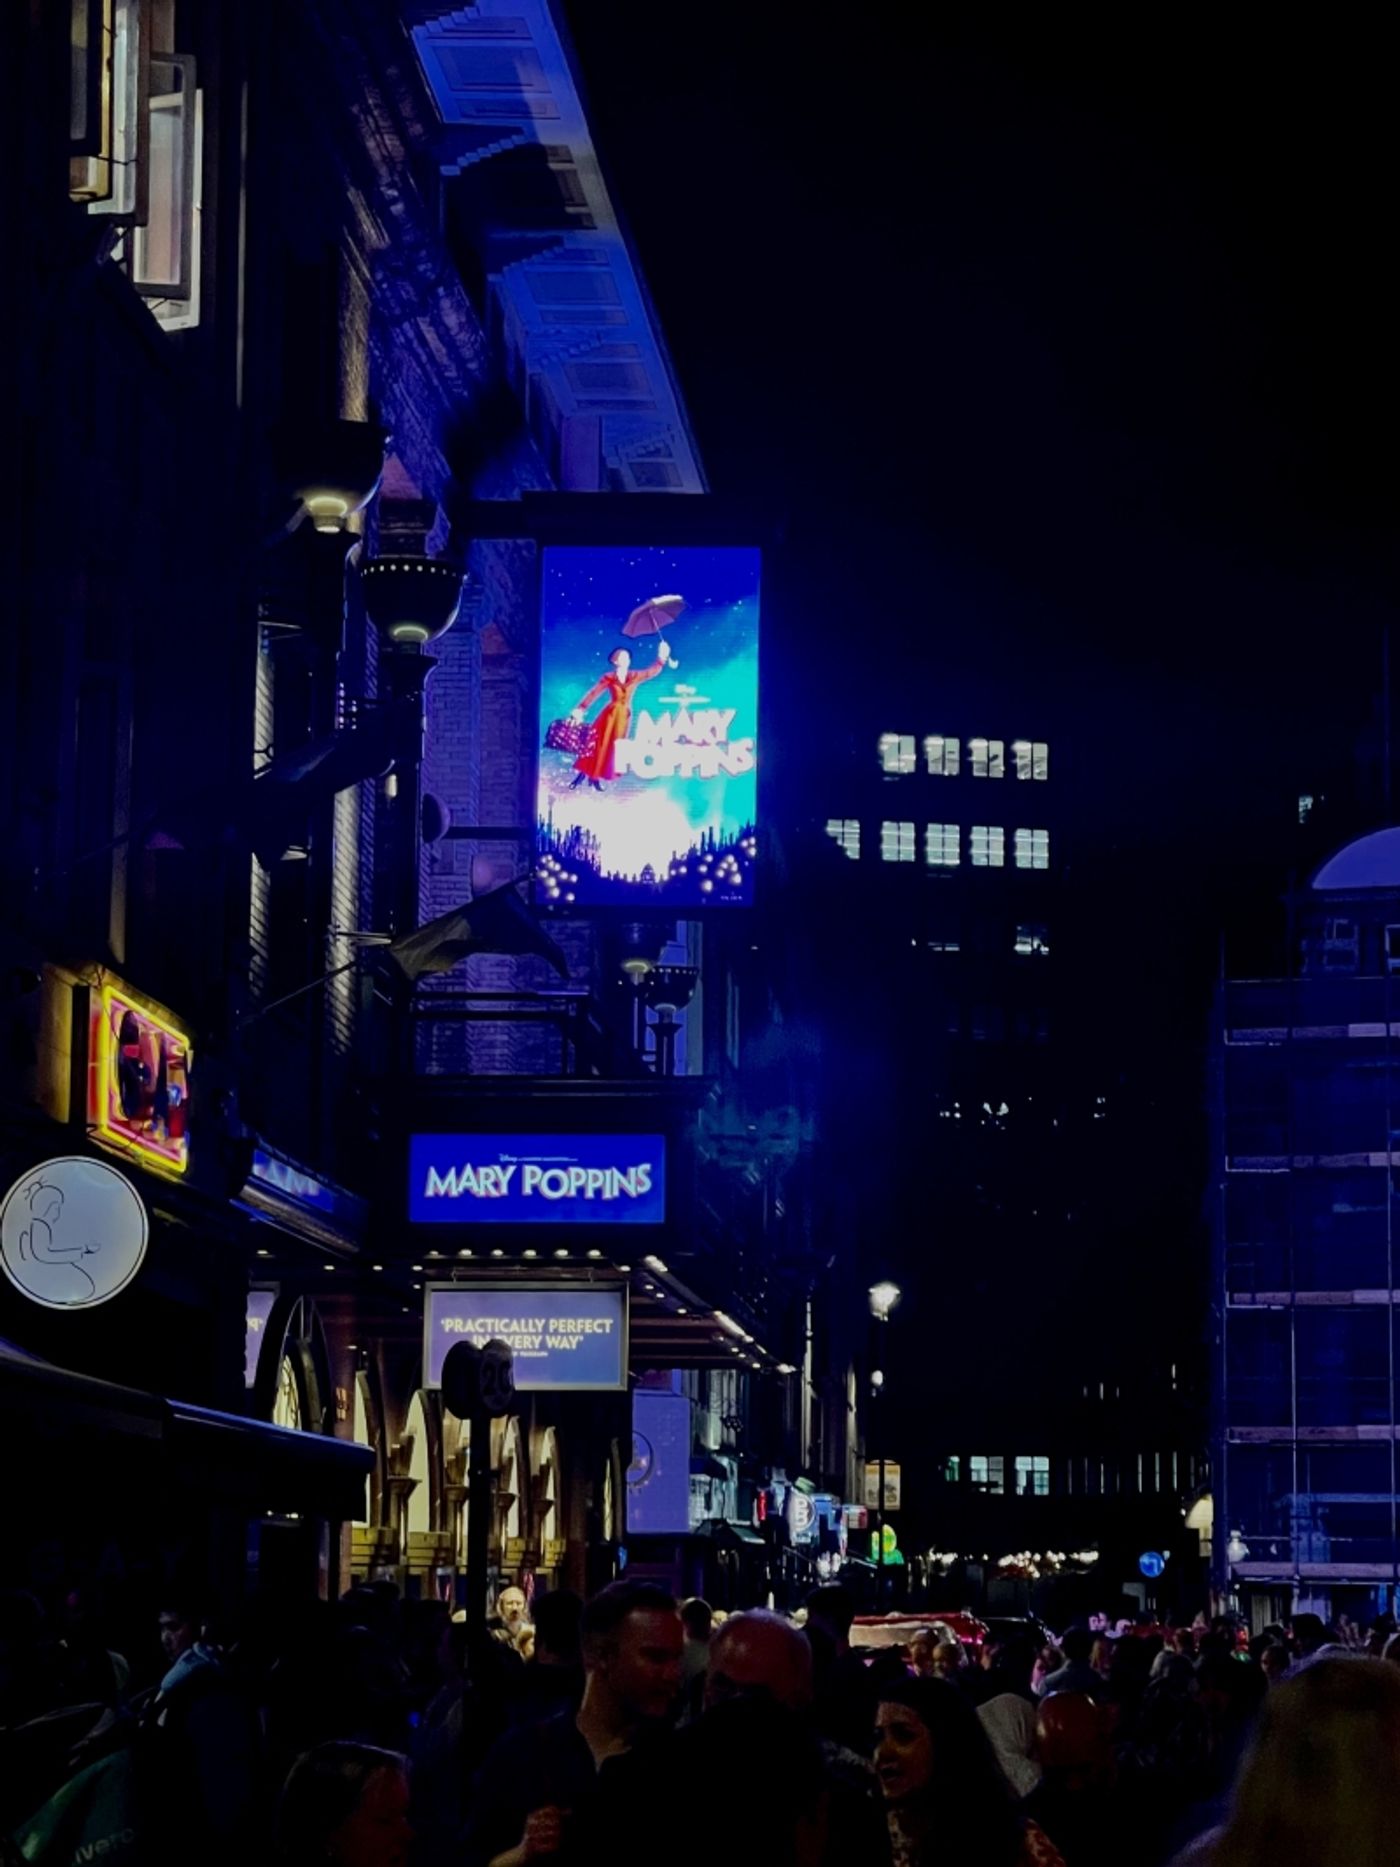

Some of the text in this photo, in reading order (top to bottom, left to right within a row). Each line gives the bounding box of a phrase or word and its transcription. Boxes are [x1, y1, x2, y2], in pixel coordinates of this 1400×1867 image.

[635, 708, 736, 746] MARY
[614, 738, 755, 779] POPPINS
[425, 1163, 652, 1200] MARY POPPINS
[495, 1335, 543, 1350] VERY
[549, 1318, 613, 1333] PERFECT
